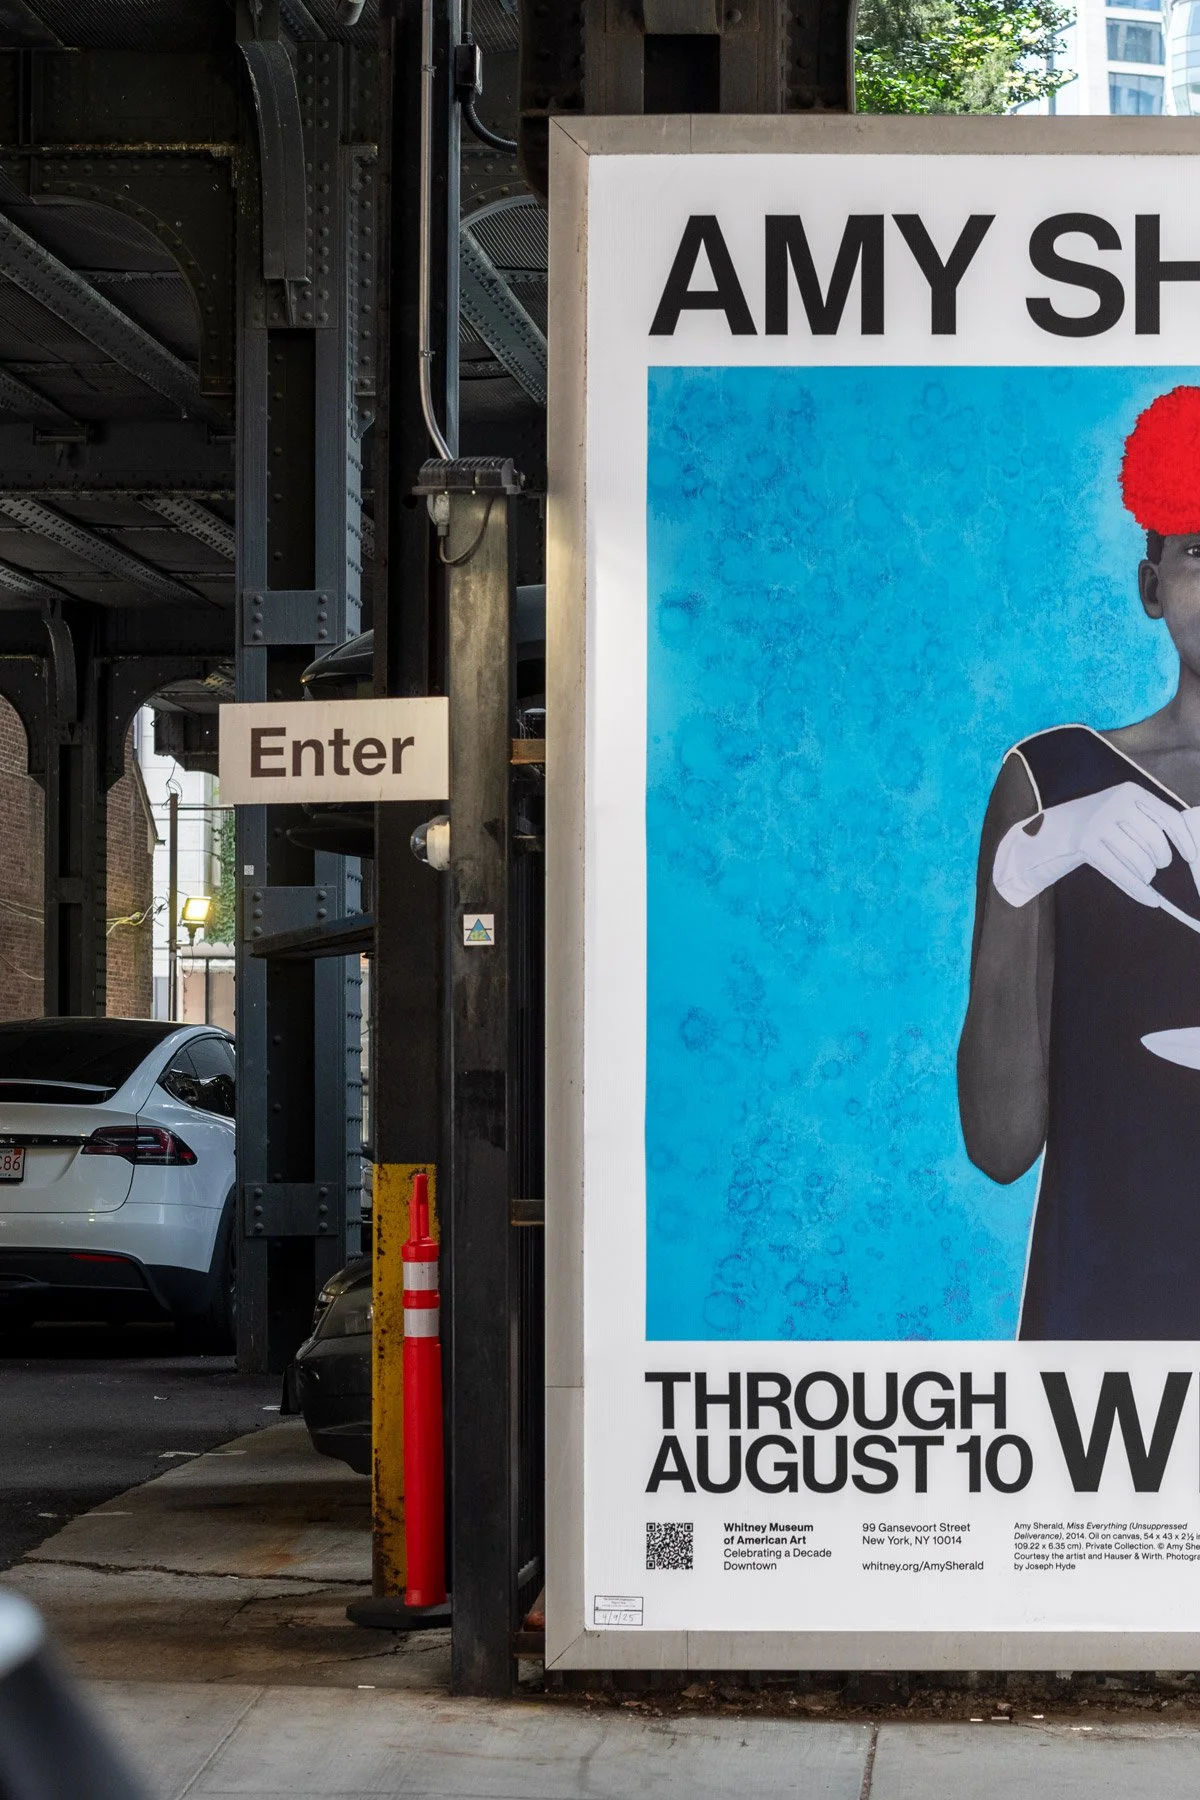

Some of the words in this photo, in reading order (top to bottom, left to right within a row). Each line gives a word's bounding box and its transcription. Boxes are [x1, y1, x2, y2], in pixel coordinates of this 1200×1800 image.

[649, 214, 996, 335] AMY
[250, 727, 415, 778] Enter
[645, 1371, 1006, 1430] THROUGH
[645, 1435, 944, 1494] AUGUST
[957, 1435, 1033, 1493] 10
[724, 1523, 767, 1533] Whitney
[769, 1523, 813, 1532] Museum
[863, 1523, 875, 1532] 99
[879, 1523, 936, 1532] Gansevoort
[940, 1523, 970, 1532] Street
[1013, 1522, 1032, 1531] Amy
[1066, 1521, 1085, 1530] Miss
[1086, 1521, 1128, 1531] Everything
[724, 1536, 734, 1545] of
[737, 1536, 787, 1544] American
[790, 1535, 806, 1544] Art
[863, 1536, 885, 1545] New
[915, 1536, 930, 1544] NY
[933, 1536, 961, 1544] 10014
[1088, 1531, 1100, 1540] Oil
[1143, 1532, 1155, 1540] 54
[1162, 1532, 1173, 1541] 43
[1085, 1541, 1113, 1550] Private
[1165, 1542, 1184, 1552] Amy
[724, 1548, 781, 1559] Celebrating
[793, 1548, 831, 1557] Decade
[1013, 1551, 1050, 1562] Courtesy
[1051, 1552, 1065, 1560] the
[1065, 1552, 1087, 1560] artist
[1087, 1552, 1103, 1560] and
[1103, 1552, 1133, 1561] Hauser
[1133, 1551, 1140, 1561] &
[724, 1561, 777, 1570] Downtown
[1013, 1562, 1024, 1572] by
[1024, 1562, 1054, 1572] Joseph
[1055, 1562, 1076, 1572] Hyde
